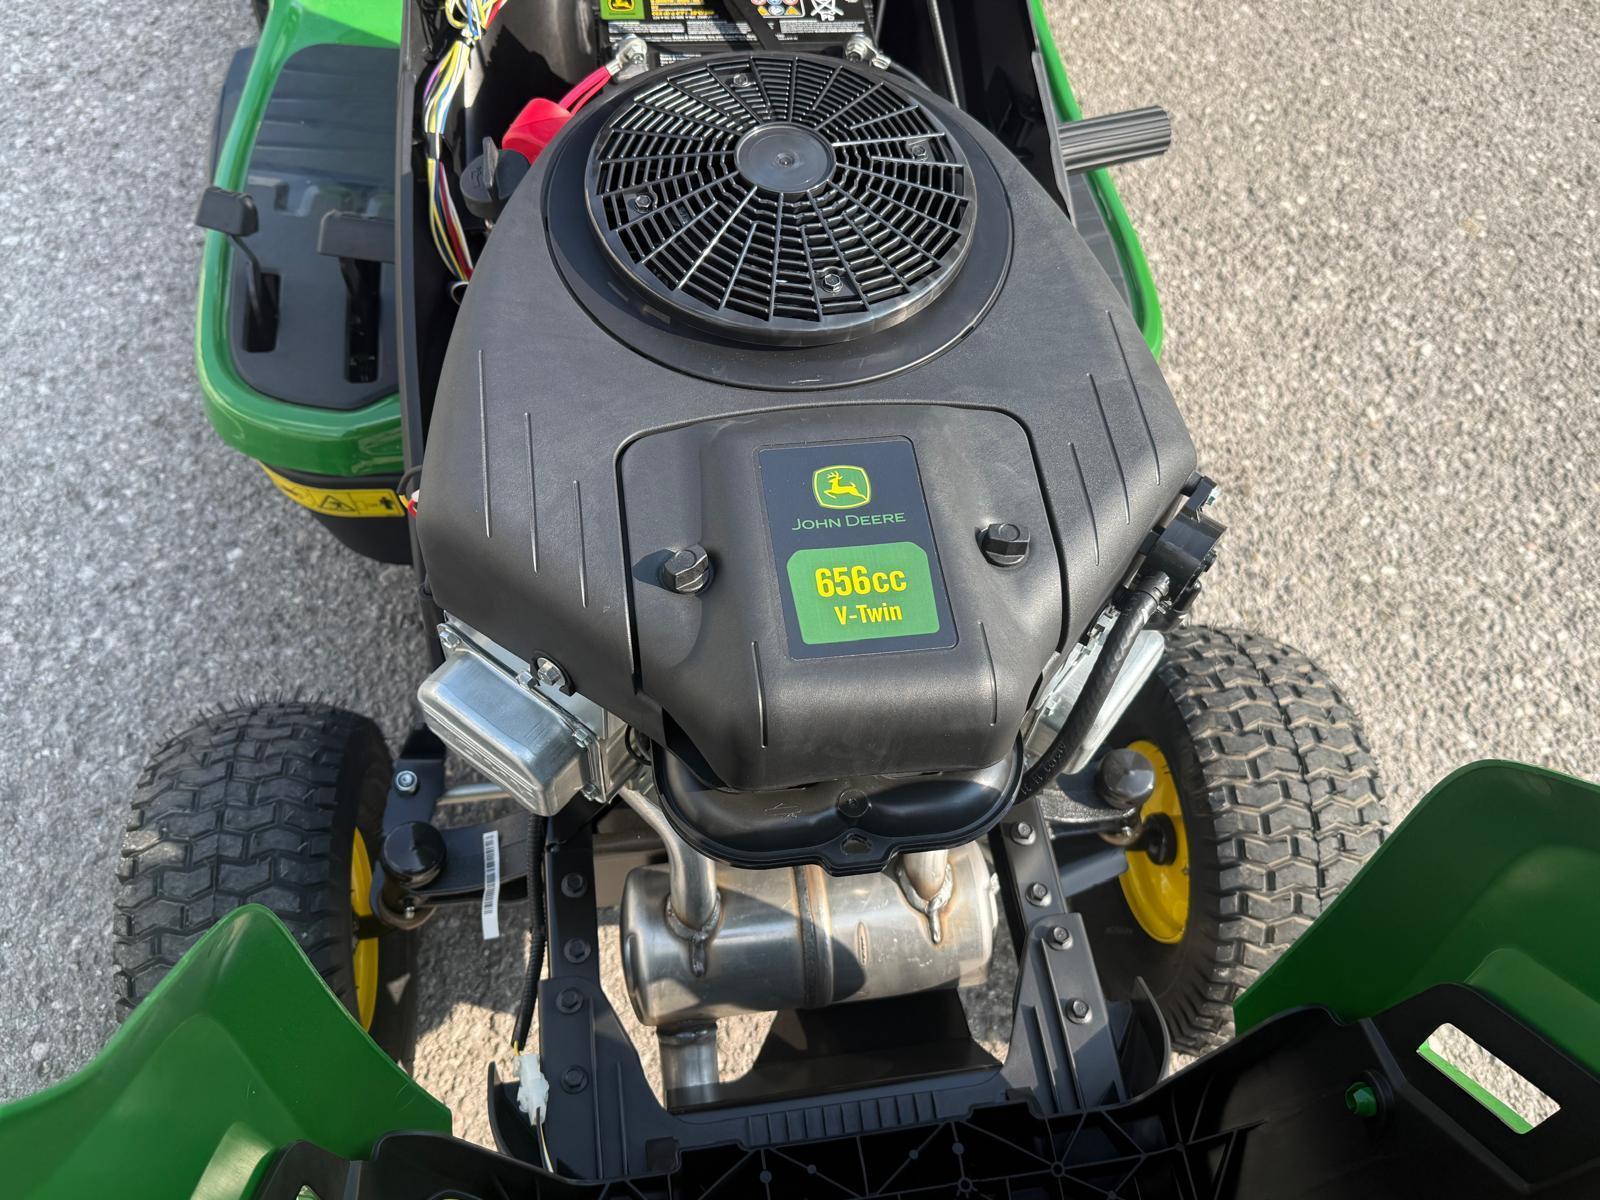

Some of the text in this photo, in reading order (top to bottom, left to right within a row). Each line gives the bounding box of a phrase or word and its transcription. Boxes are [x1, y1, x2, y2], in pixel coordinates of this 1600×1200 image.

[791, 512, 906, 531] JOHN DEERE
[814, 565, 907, 598] 656cc
[833, 602, 903, 625] V-Twin
